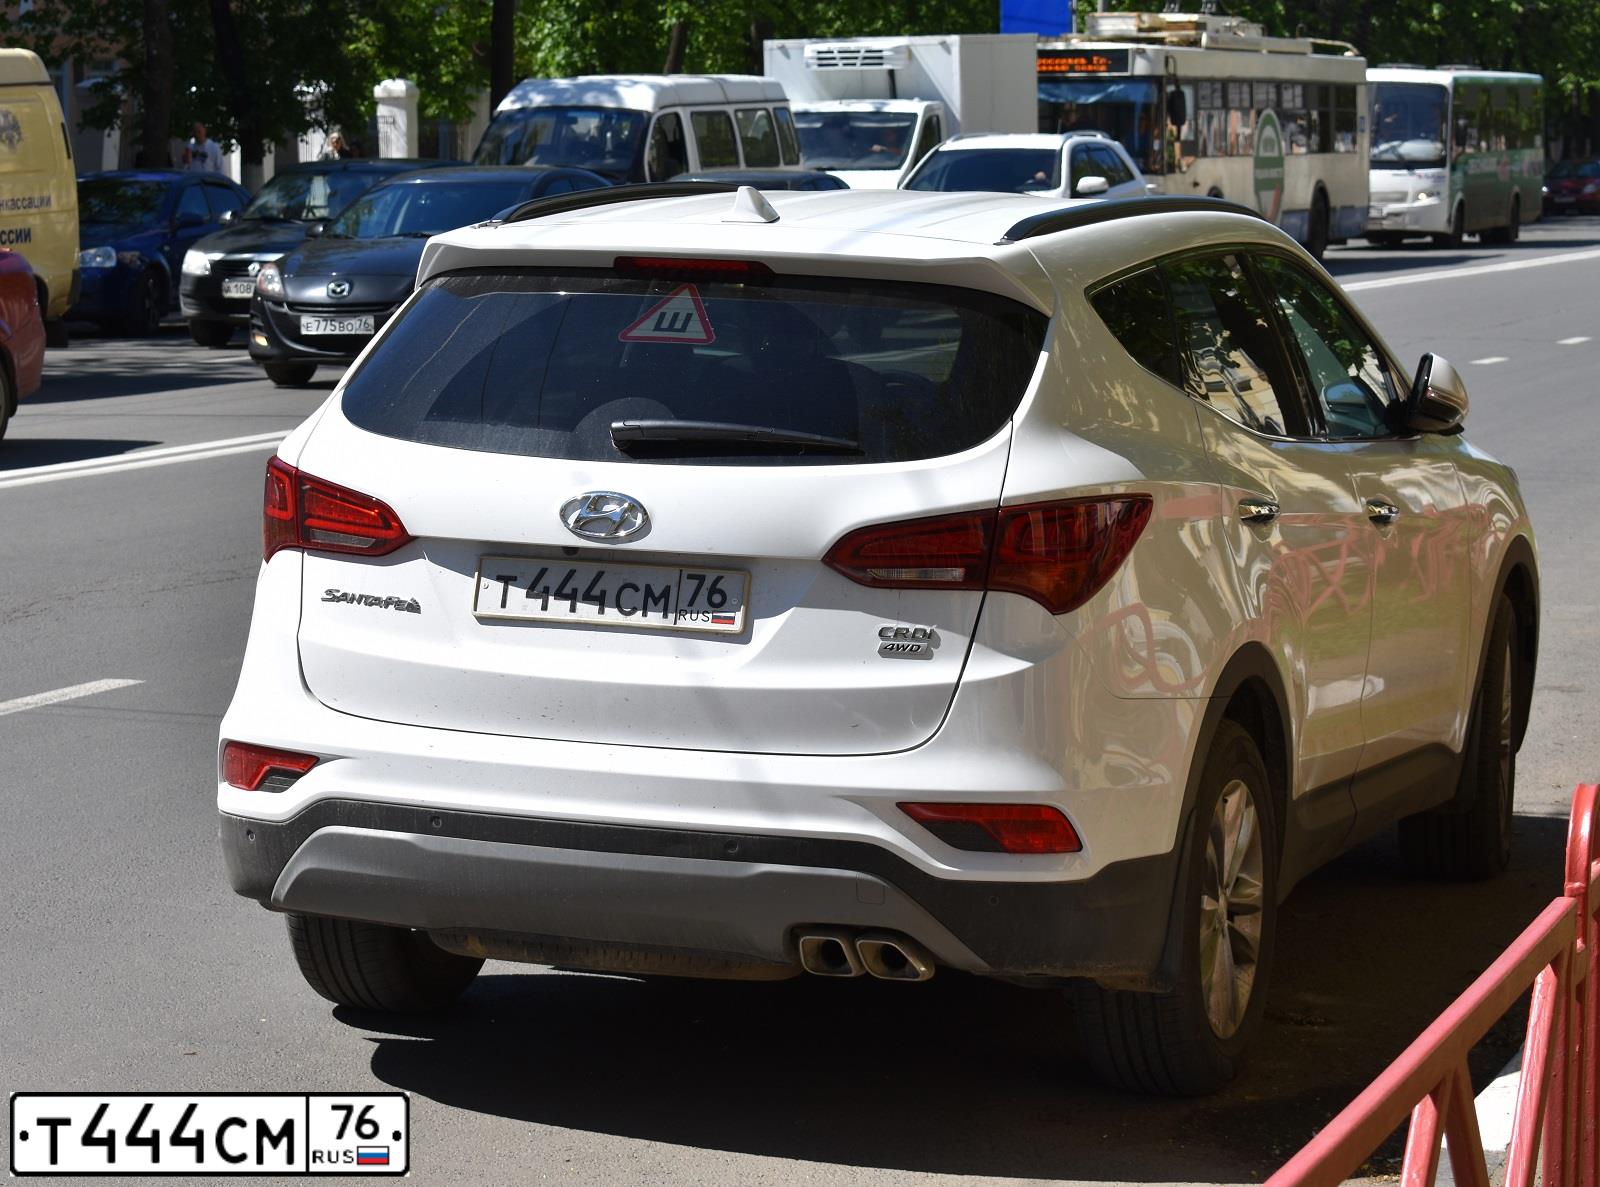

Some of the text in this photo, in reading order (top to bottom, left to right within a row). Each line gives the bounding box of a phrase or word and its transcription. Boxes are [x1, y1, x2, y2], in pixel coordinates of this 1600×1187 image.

[652, 311, 693, 333] Ш
[496, 567, 728, 619] Т444СМ 76
[678, 608, 710, 623] RUS
[883, 643, 922, 652] 4WD
